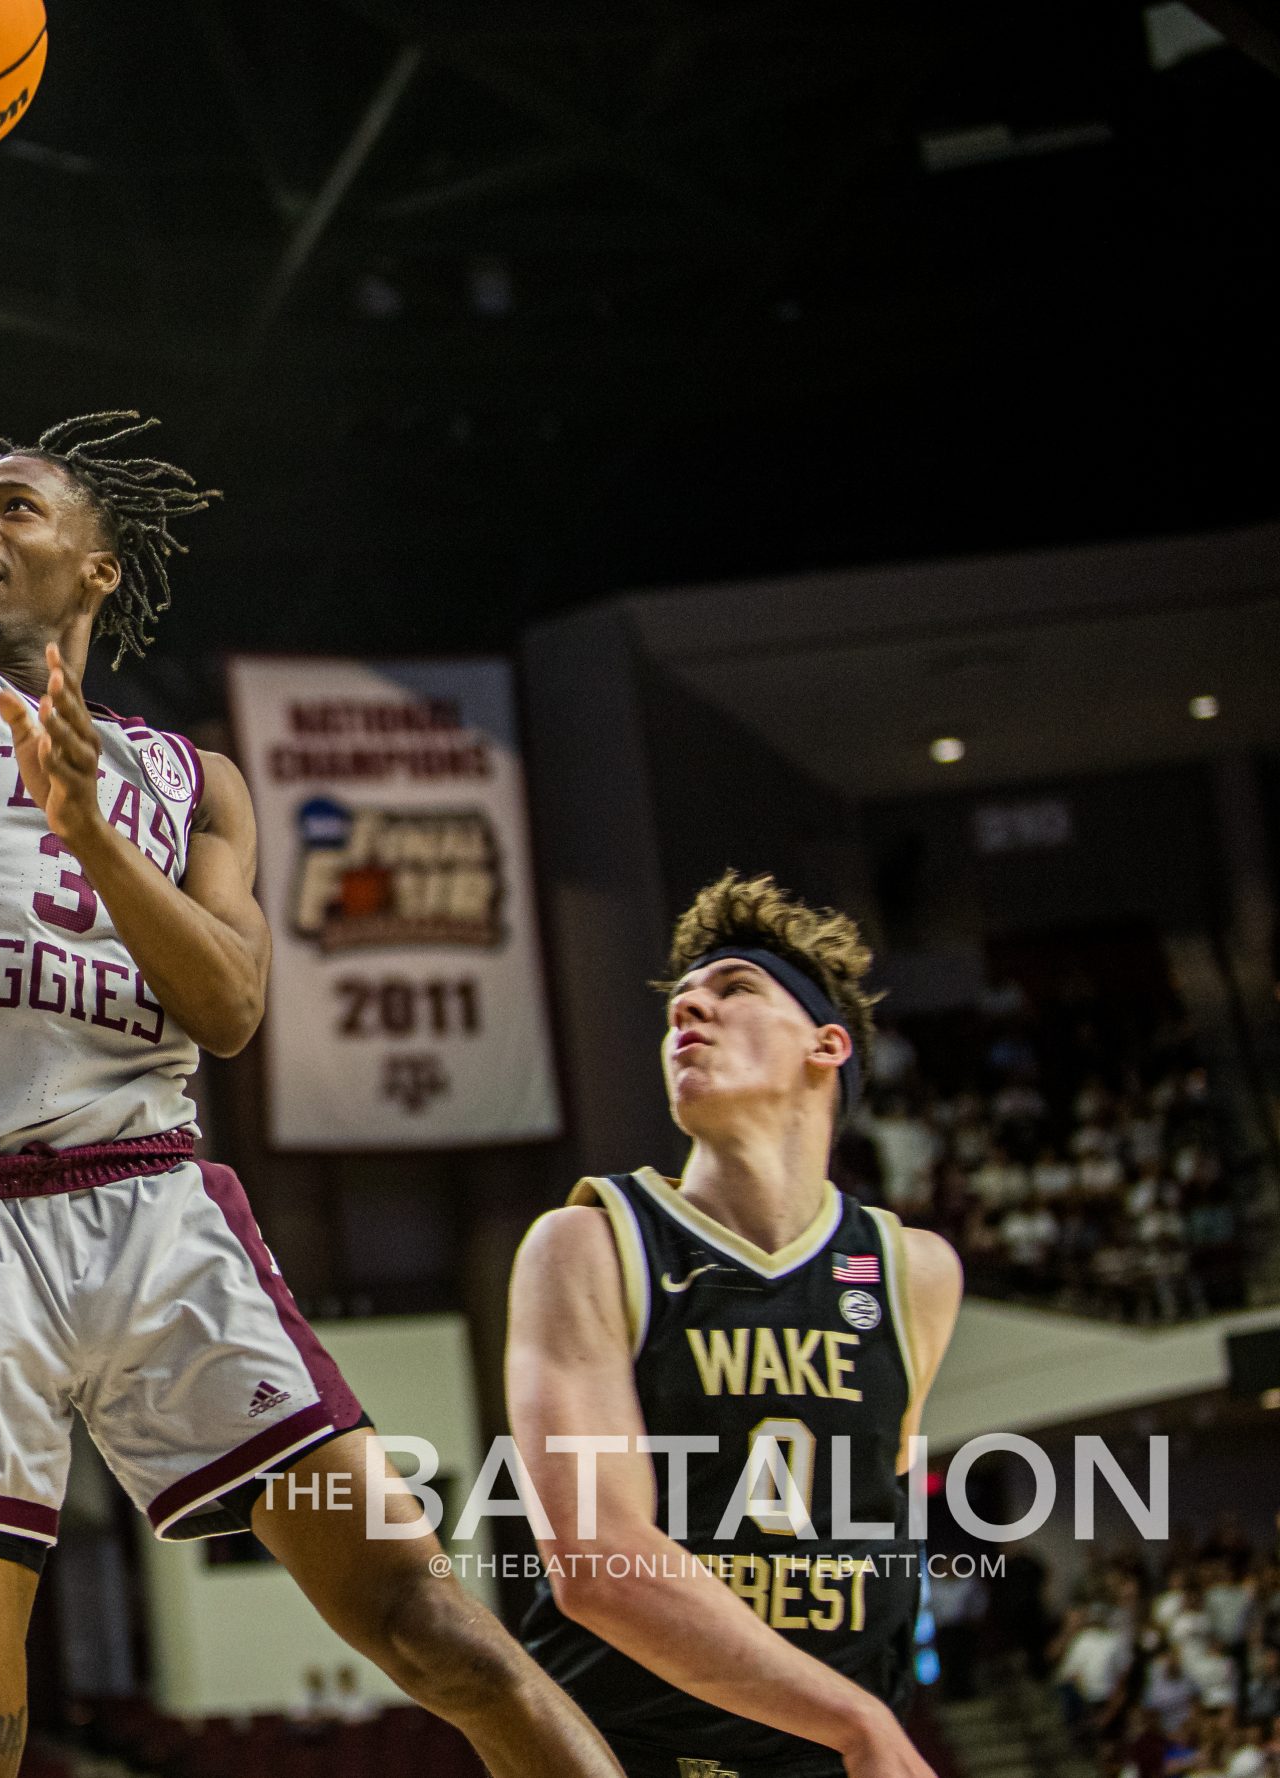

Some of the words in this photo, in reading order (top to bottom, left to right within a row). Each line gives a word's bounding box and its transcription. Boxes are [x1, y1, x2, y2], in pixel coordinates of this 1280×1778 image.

[145, 761, 184, 800] GRADUATE
[150, 743, 181, 787] SEC
[269, 744, 492, 784] CHAMPIONS
[33, 833, 97, 934] 3
[334, 974, 482, 1038] 2011
[685, 1327, 863, 1402] WAKE
[248, 1392, 291, 1417] adidas
[699, 1554, 874, 1632] REST
